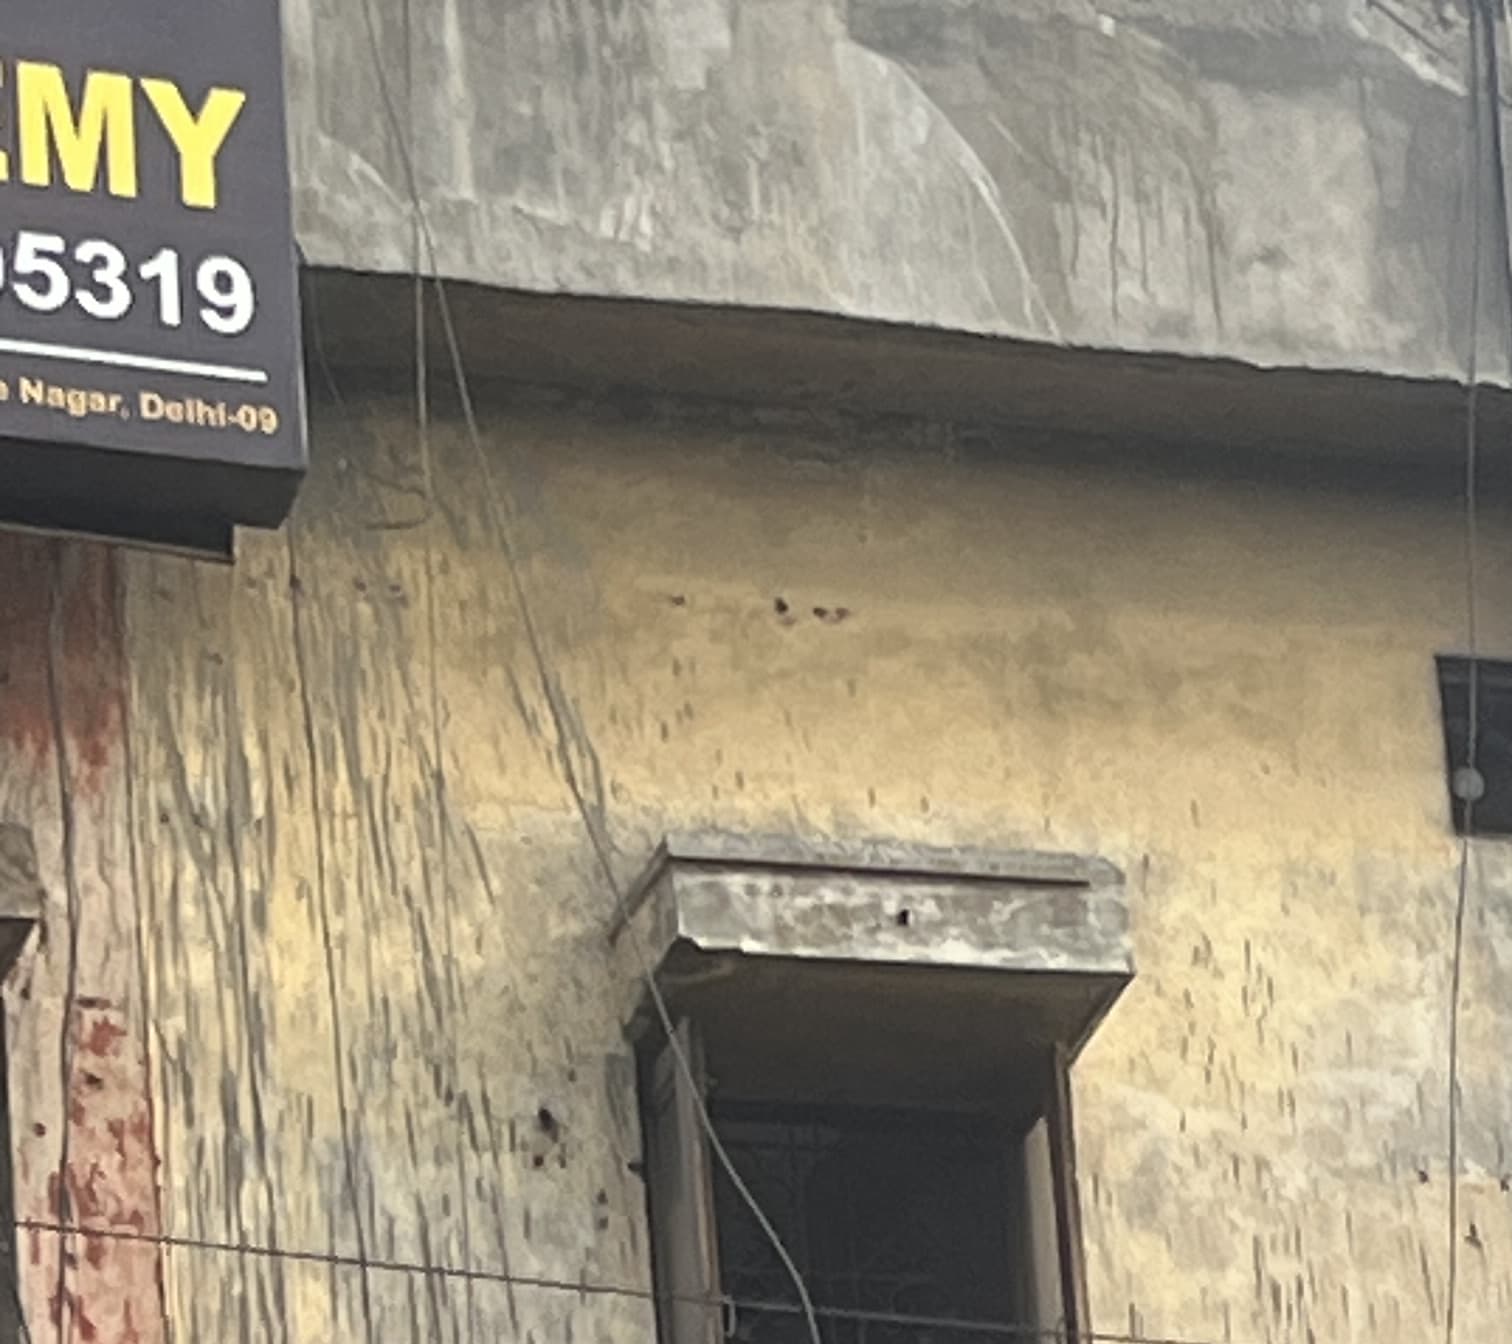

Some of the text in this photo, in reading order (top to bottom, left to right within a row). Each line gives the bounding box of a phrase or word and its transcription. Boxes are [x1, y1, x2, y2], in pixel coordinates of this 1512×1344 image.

[0, 61, 245, 208] MY
[0, 231, 255, 335] 5319
[140, 387, 279, 434] Delhi-09
